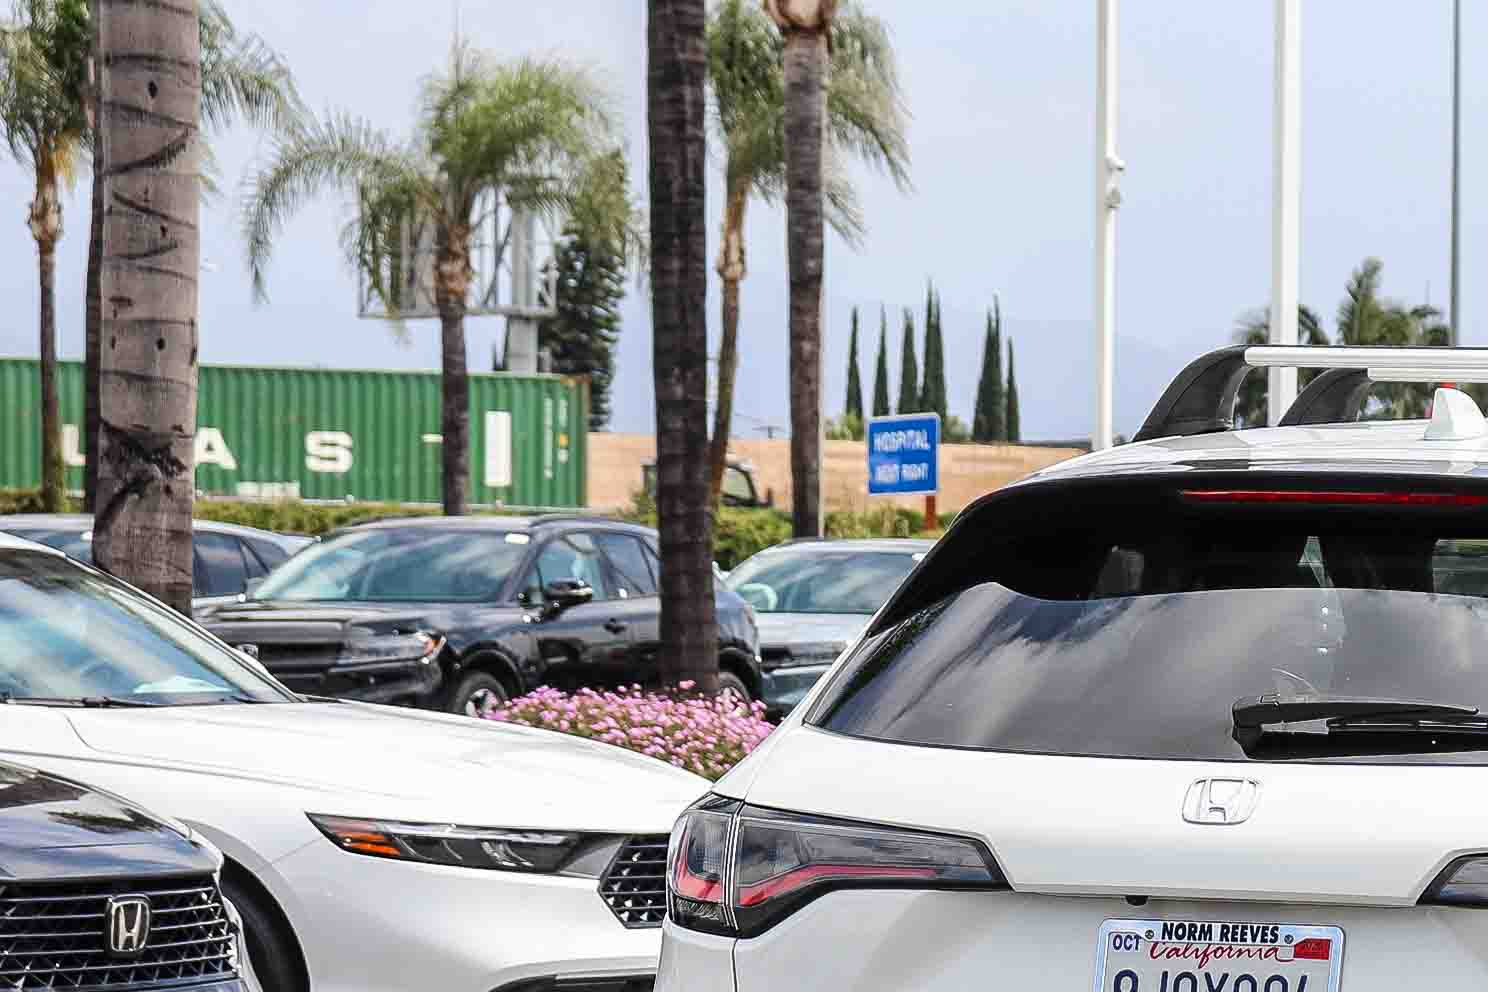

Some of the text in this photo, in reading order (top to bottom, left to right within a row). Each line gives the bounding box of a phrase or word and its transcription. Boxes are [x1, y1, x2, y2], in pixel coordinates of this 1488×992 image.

[1112, 934, 1142, 951] OCT
[1161, 922, 1280, 944] NORM REEVES
[1150, 941, 1294, 969] California
